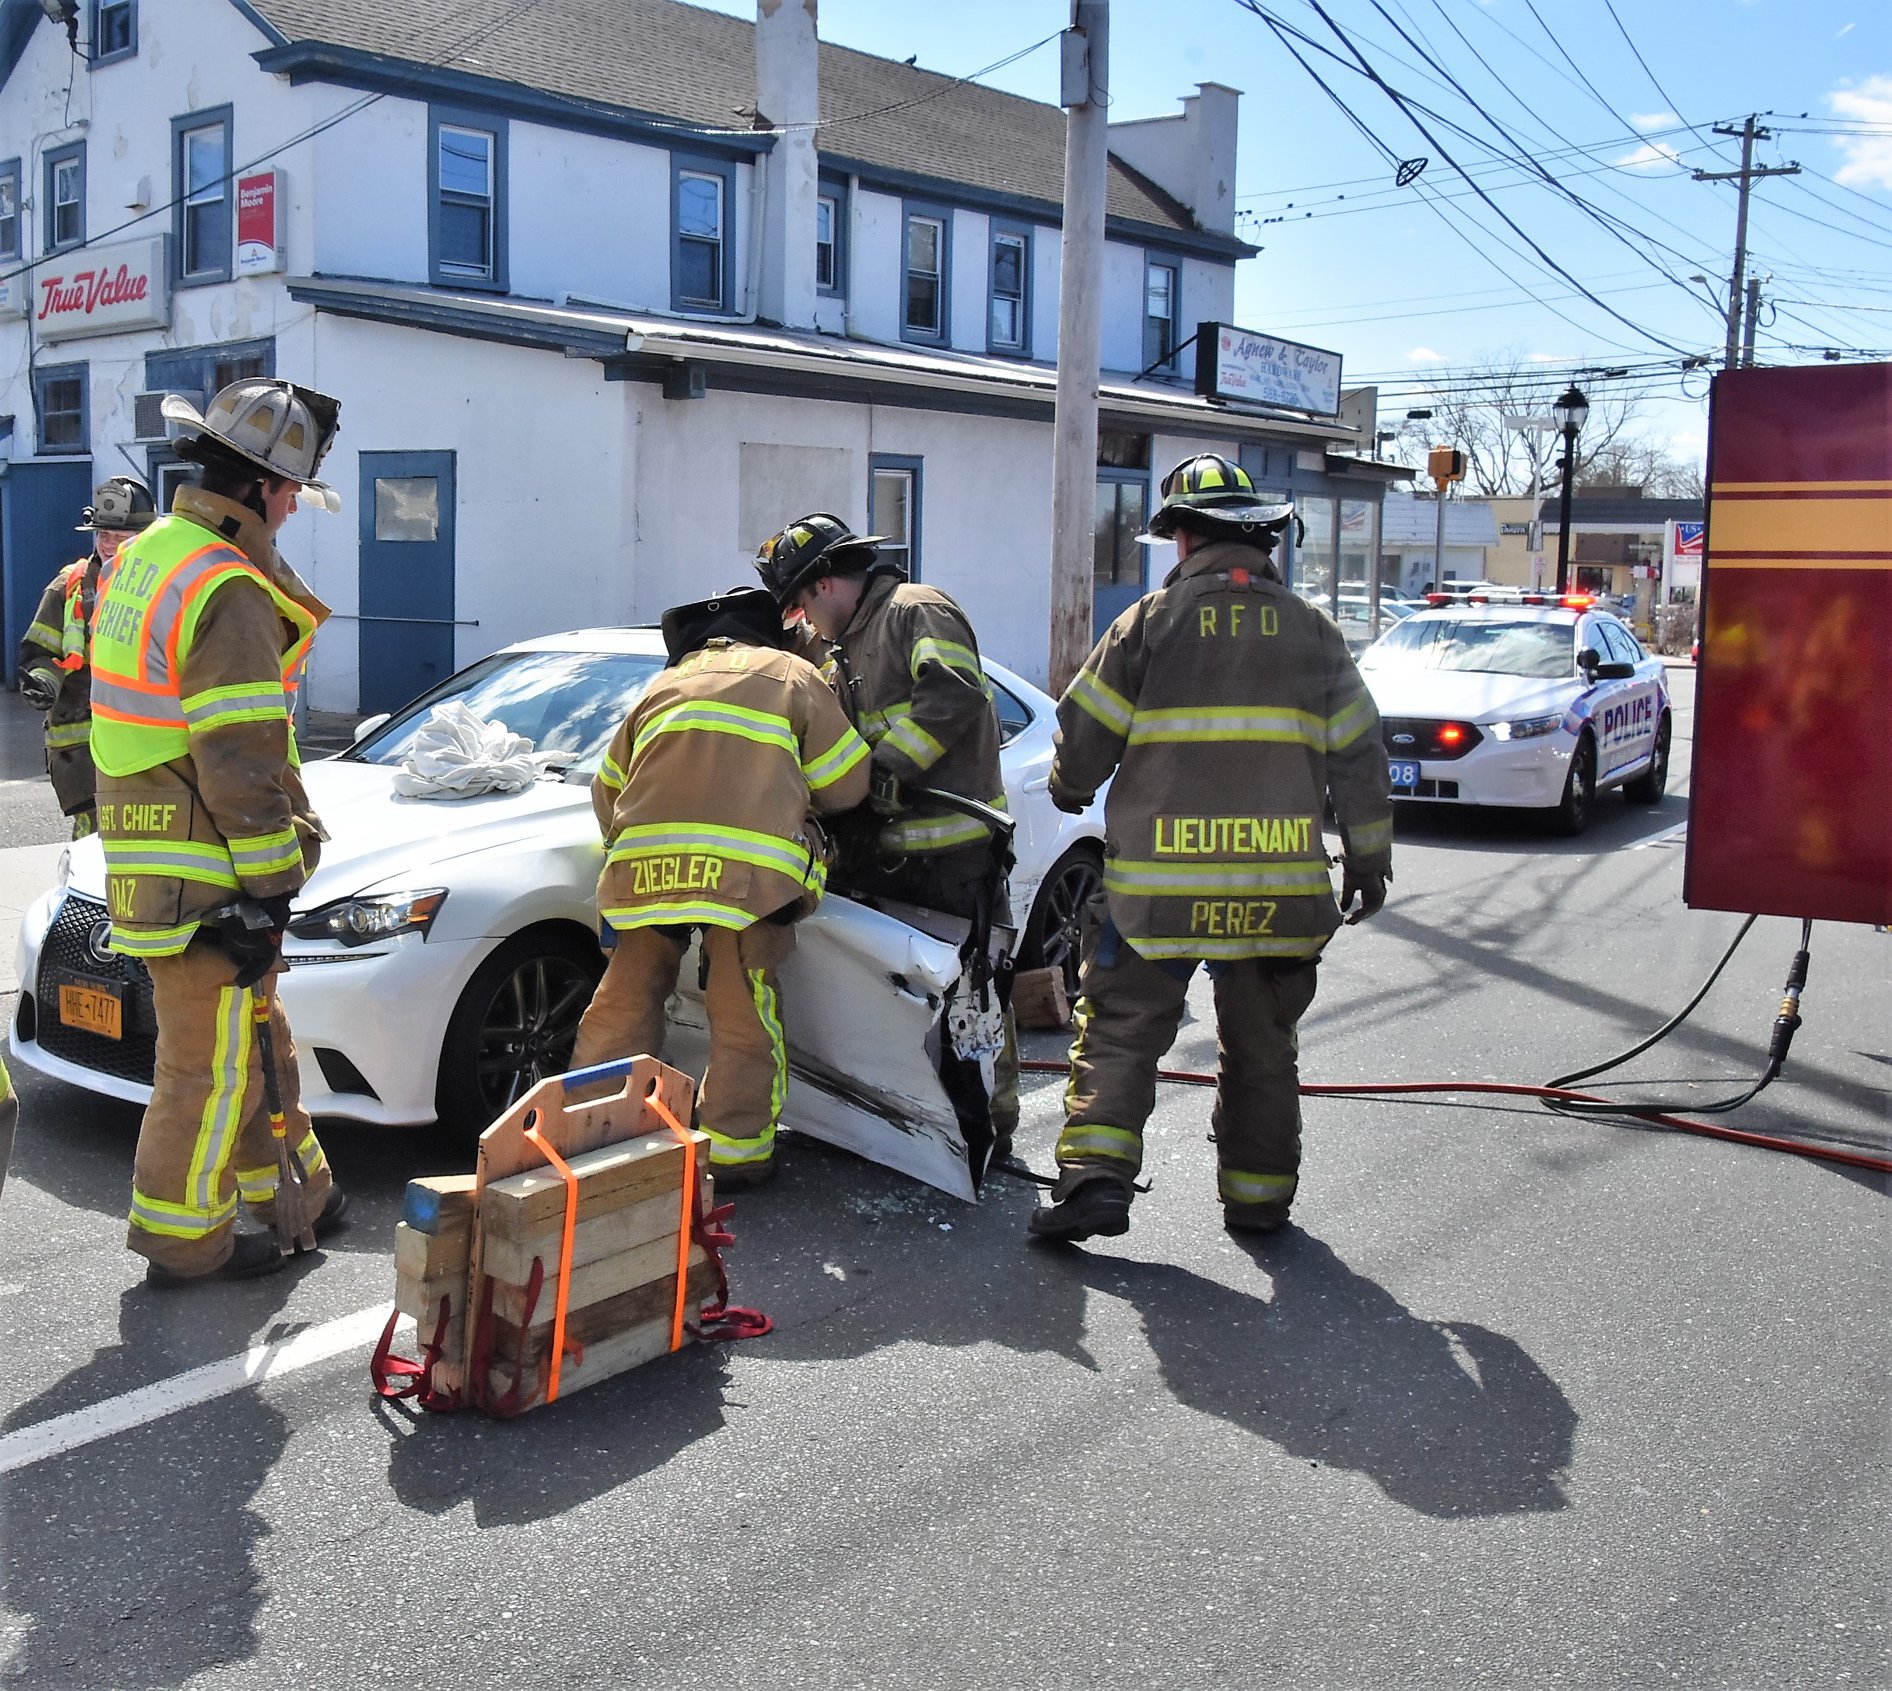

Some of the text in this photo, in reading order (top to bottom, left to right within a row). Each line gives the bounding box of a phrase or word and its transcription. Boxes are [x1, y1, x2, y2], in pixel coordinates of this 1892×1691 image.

[240, 184, 273, 199] Benjamin
[240, 197, 264, 209] Moore
[1233, 337, 1274, 361] Agnew
[97, 599, 143, 647] CHIEF
[1604, 696, 1652, 748] POLICE
[123, 804, 177, 831] CHIEF
[1154, 817, 1313, 854] LIEUTENANT
[630, 855, 724, 896] ZIEGLER
[1190, 900, 1278, 935] PEREZ
